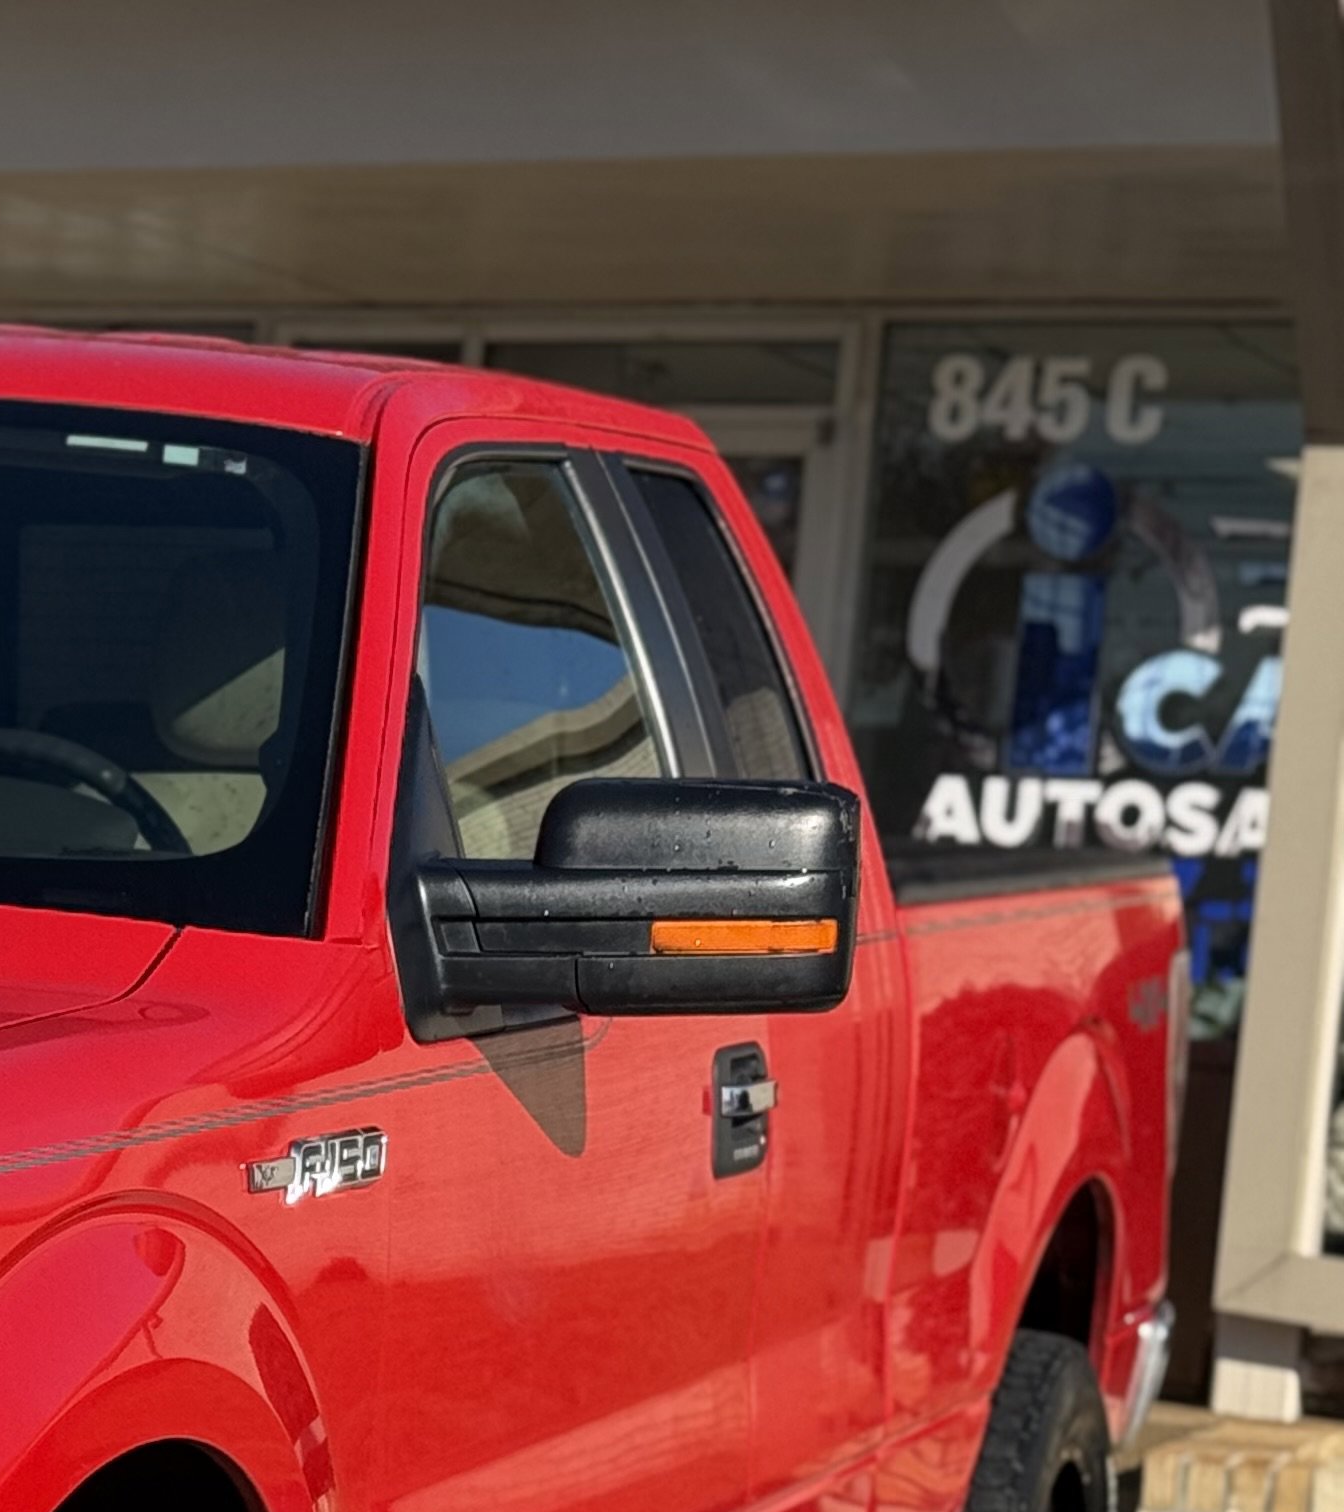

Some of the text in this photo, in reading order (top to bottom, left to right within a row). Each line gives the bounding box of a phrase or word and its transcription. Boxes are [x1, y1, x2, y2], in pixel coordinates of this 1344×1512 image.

[928, 354, 1169, 444] 845 C
[1000, 462, 1282, 776] iCA
[922, 774, 1271, 858] AUTOSA
